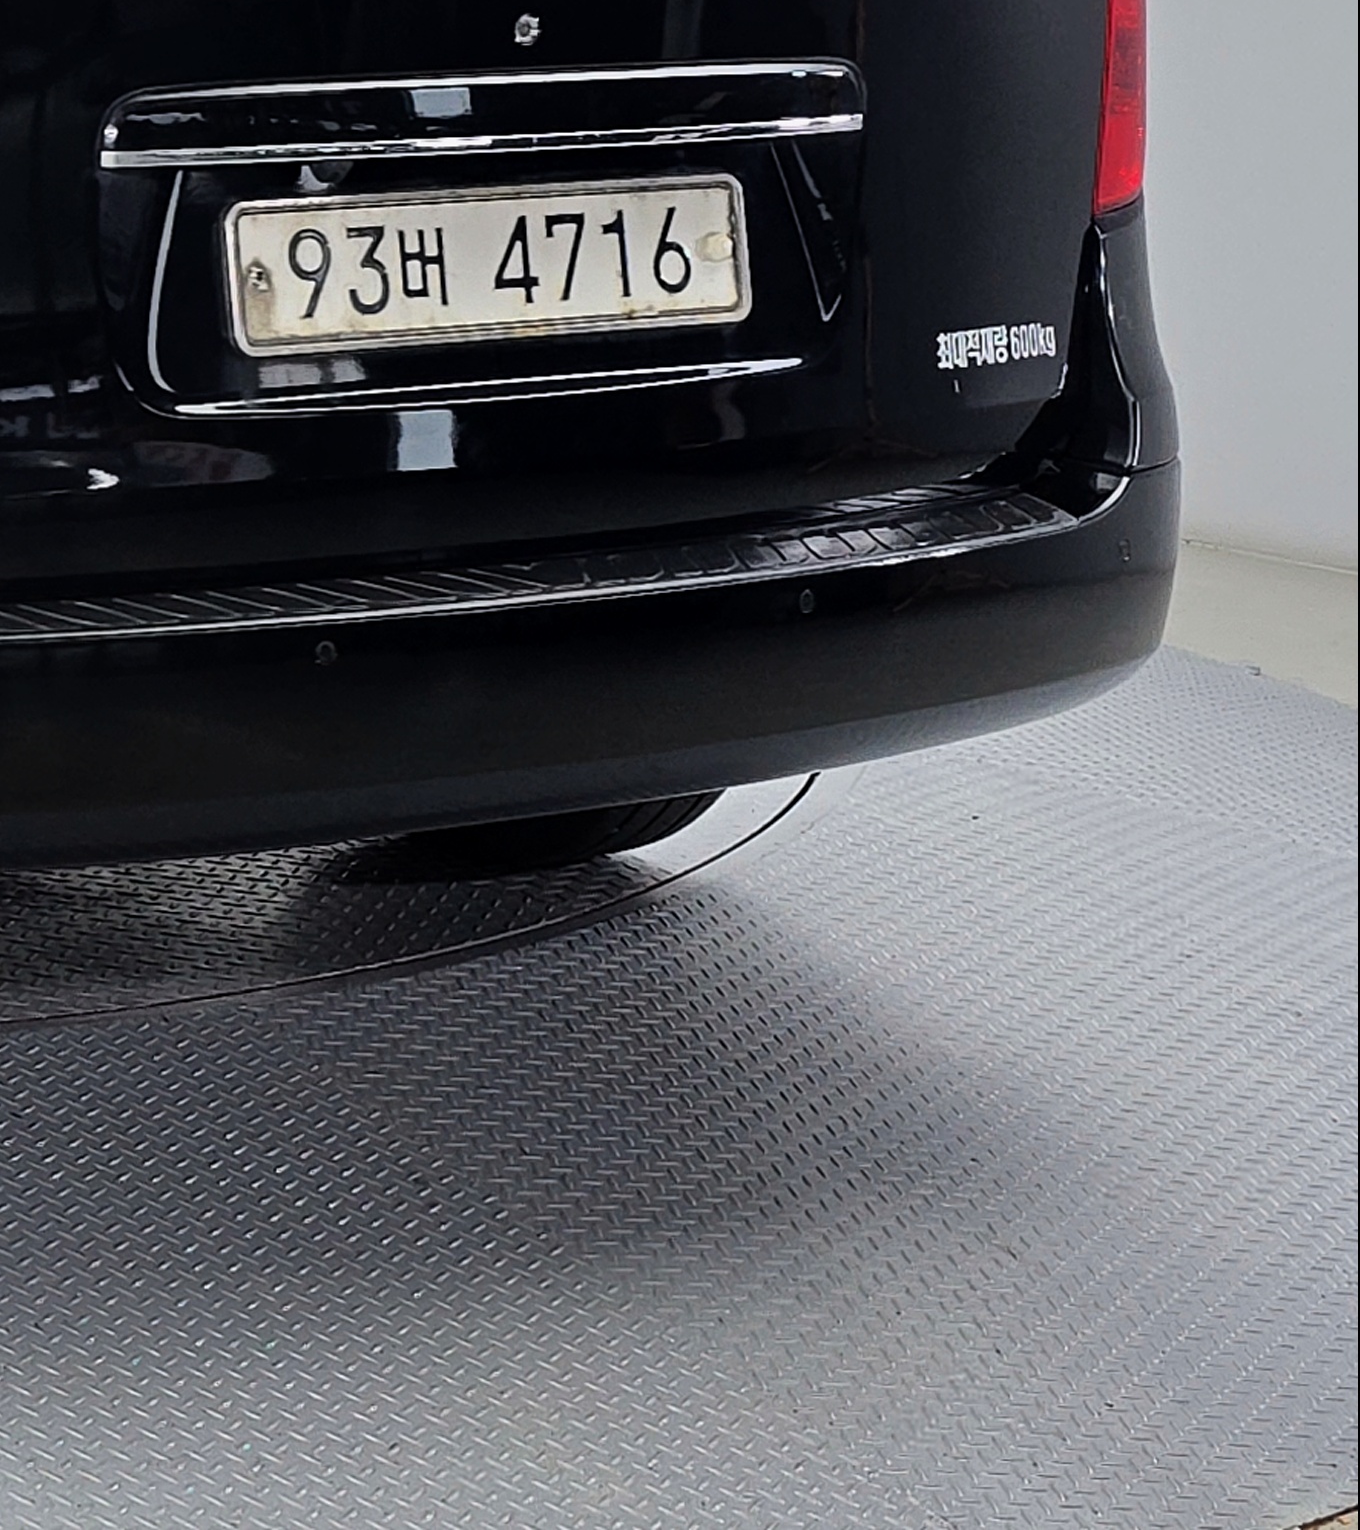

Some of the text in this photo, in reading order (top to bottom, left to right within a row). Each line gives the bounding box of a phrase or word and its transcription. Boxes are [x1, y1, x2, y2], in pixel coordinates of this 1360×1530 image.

[287, 205, 692, 319] 93버 4716
[1010, 322, 1056, 360] 600kg
